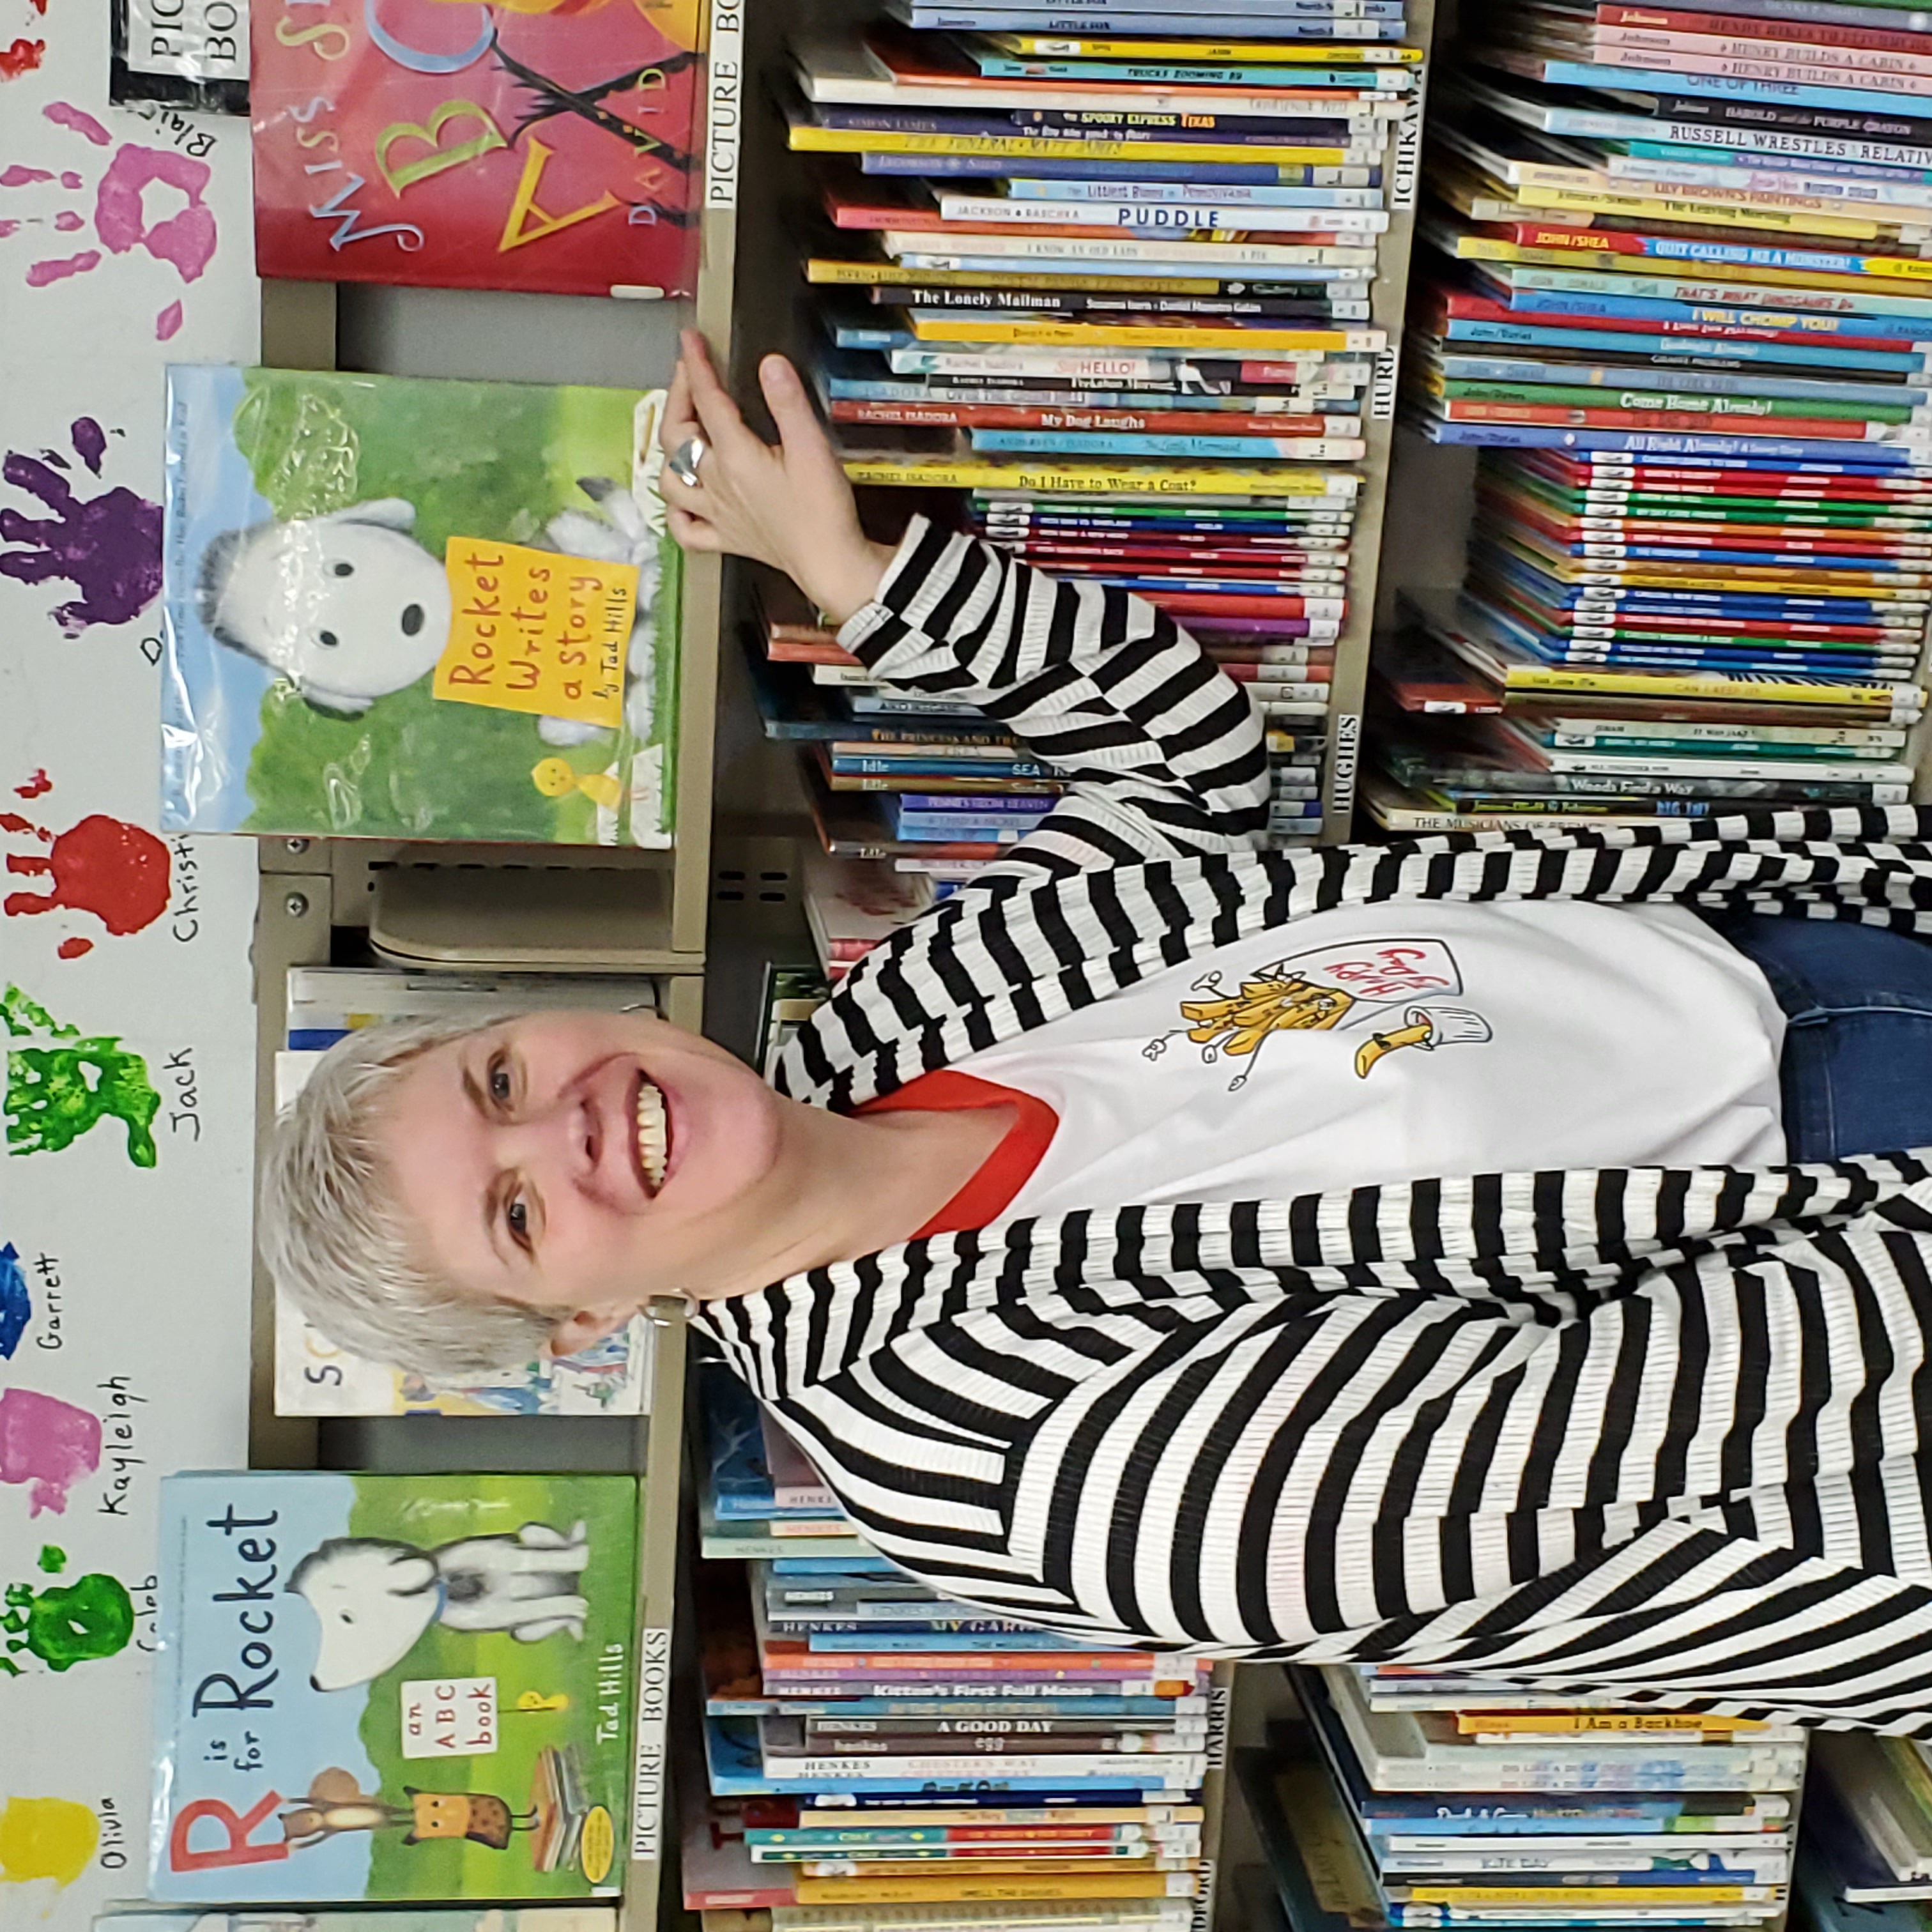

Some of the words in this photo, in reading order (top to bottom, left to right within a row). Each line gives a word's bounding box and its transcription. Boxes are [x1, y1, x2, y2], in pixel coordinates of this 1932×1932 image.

[1730, 42, 1779, 59] HENRY
[1784, 48, 1839, 64] BUILDS
[1845, 54, 1855, 65] A
[1859, 55, 1904, 71] CABIN
[1686, 75, 1721, 89] ONE
[1726, 78, 1749, 91] OF
[1751, 82, 1800, 95] THREE
[1731, 62, 1780, 79] HENRY
[1784, 67, 1839, 84] BUILDS
[1844, 73, 1855, 84] A
[1860, 75, 1905, 89] CABIN
[628, 66, 668, 226] DAVID
[710, 60, 739, 203] PICTURE
[1393, 65, 1423, 203] ICHIKAWA
[1669, 125, 1747, 147] RUSSELL
[1753, 134, 1846, 157] WRESTLES
[958, 206, 1011, 217] JACKSON
[1117, 208, 1219, 227] PUDDLE
[912, 289, 939, 304] The
[943, 291, 993, 308] Lonely
[996, 293, 1061, 309] Mailman
[1674, 286, 1717, 299] THAT'S
[1702, 310, 1736, 325] WILL
[1080, 361, 1137, 375] HELLO!
[1374, 346, 1395, 416] HURD
[1620, 392, 1664, 410] Come
[1665, 394, 1708, 411] Home
[1710, 398, 1772, 416] Already!
[857, 410, 903, 420] RACHEL
[905, 410, 957, 423] ISADORA
[1040, 413, 1062, 427] My
[1065, 414, 1091, 428] Dog
[1095, 415, 1146, 429] Laughs
[1624, 435, 1646, 450] All
[1019, 475, 1038, 487] Do
[1040, 477, 1048, 487] I
[1050, 477, 1085, 489] Have
[1089, 478, 1103, 489] to
[1107, 479, 1144, 491] Wear
[1147, 481, 1155, 491] a
[1159, 479, 1197, 492] Coat?
[448, 552, 503, 684] Rocket
[556, 574, 602, 666] Story
[602, 586, 629, 632] Hills
[506, 565, 551, 689] Writes
[600, 640, 620, 674] Tad
[565, 678, 583, 700] a
[593, 683, 620, 699] by
[1675, 683, 1698, 694] CAN
[1712, 685, 1742, 696] KEEP
[862, 759, 889, 772] Idle
[1011, 763, 1041, 776] SEA
[1334, 716, 1357, 811] HUGHES
[1619, 780, 1650, 793] Find
[1651, 783, 1661, 794] a
[1663, 781, 1694, 795] Way
[1413, 816, 1441, 829] THE
[1446, 818, 1528, 831] MUSICIANS
[1375, 947, 1427, 976] Day
[163, 1046, 200, 1141] Jack
[36, 1251, 63, 1349] Garrett
[97, 1375, 148, 1515] Kayleigh
[735, 1545, 783, 1554] HENKES
[192, 1502, 279, 1717] Rocket
[783, 1621, 857, 1632] HENKES
[598, 1642, 624, 1694] Hills
[642, 1630, 668, 1722] BOOKS
[873, 1683, 949, 1697] Kitten's
[953, 1685, 997, 1697] First
[1001, 1685, 1037, 1697] Full
[1041, 1685, 1093, 1698] Moon
[407, 1702, 422, 1735] an
[467, 1682, 493, 1744] book
[597, 1701, 620, 1744] Tad
[937, 1721, 951, 1733] A
[955, 1721, 1012, 1733] GOOD
[1016, 1721, 1054, 1733] DAY
[1574, 1717, 1580, 1729] I
[1586, 1717, 1612, 1729] Am
[1618, 1720, 1627, 1729] a
[1634, 1717, 1703, 1729] Backhoe
[1206, 1689, 1225, 1767] HARRIS
[203, 1739, 228, 1760] is
[234, 1730, 263, 1772] for
[833, 1739, 889, 1752] henkes
[974, 1736, 1006, 1752] egg
[804, 1760, 871, 1770] HENKES
[635, 1742, 663, 1853] PICTURE
[100, 1797, 127, 1867] Olivia
[170, 1788, 289, 1871] R
